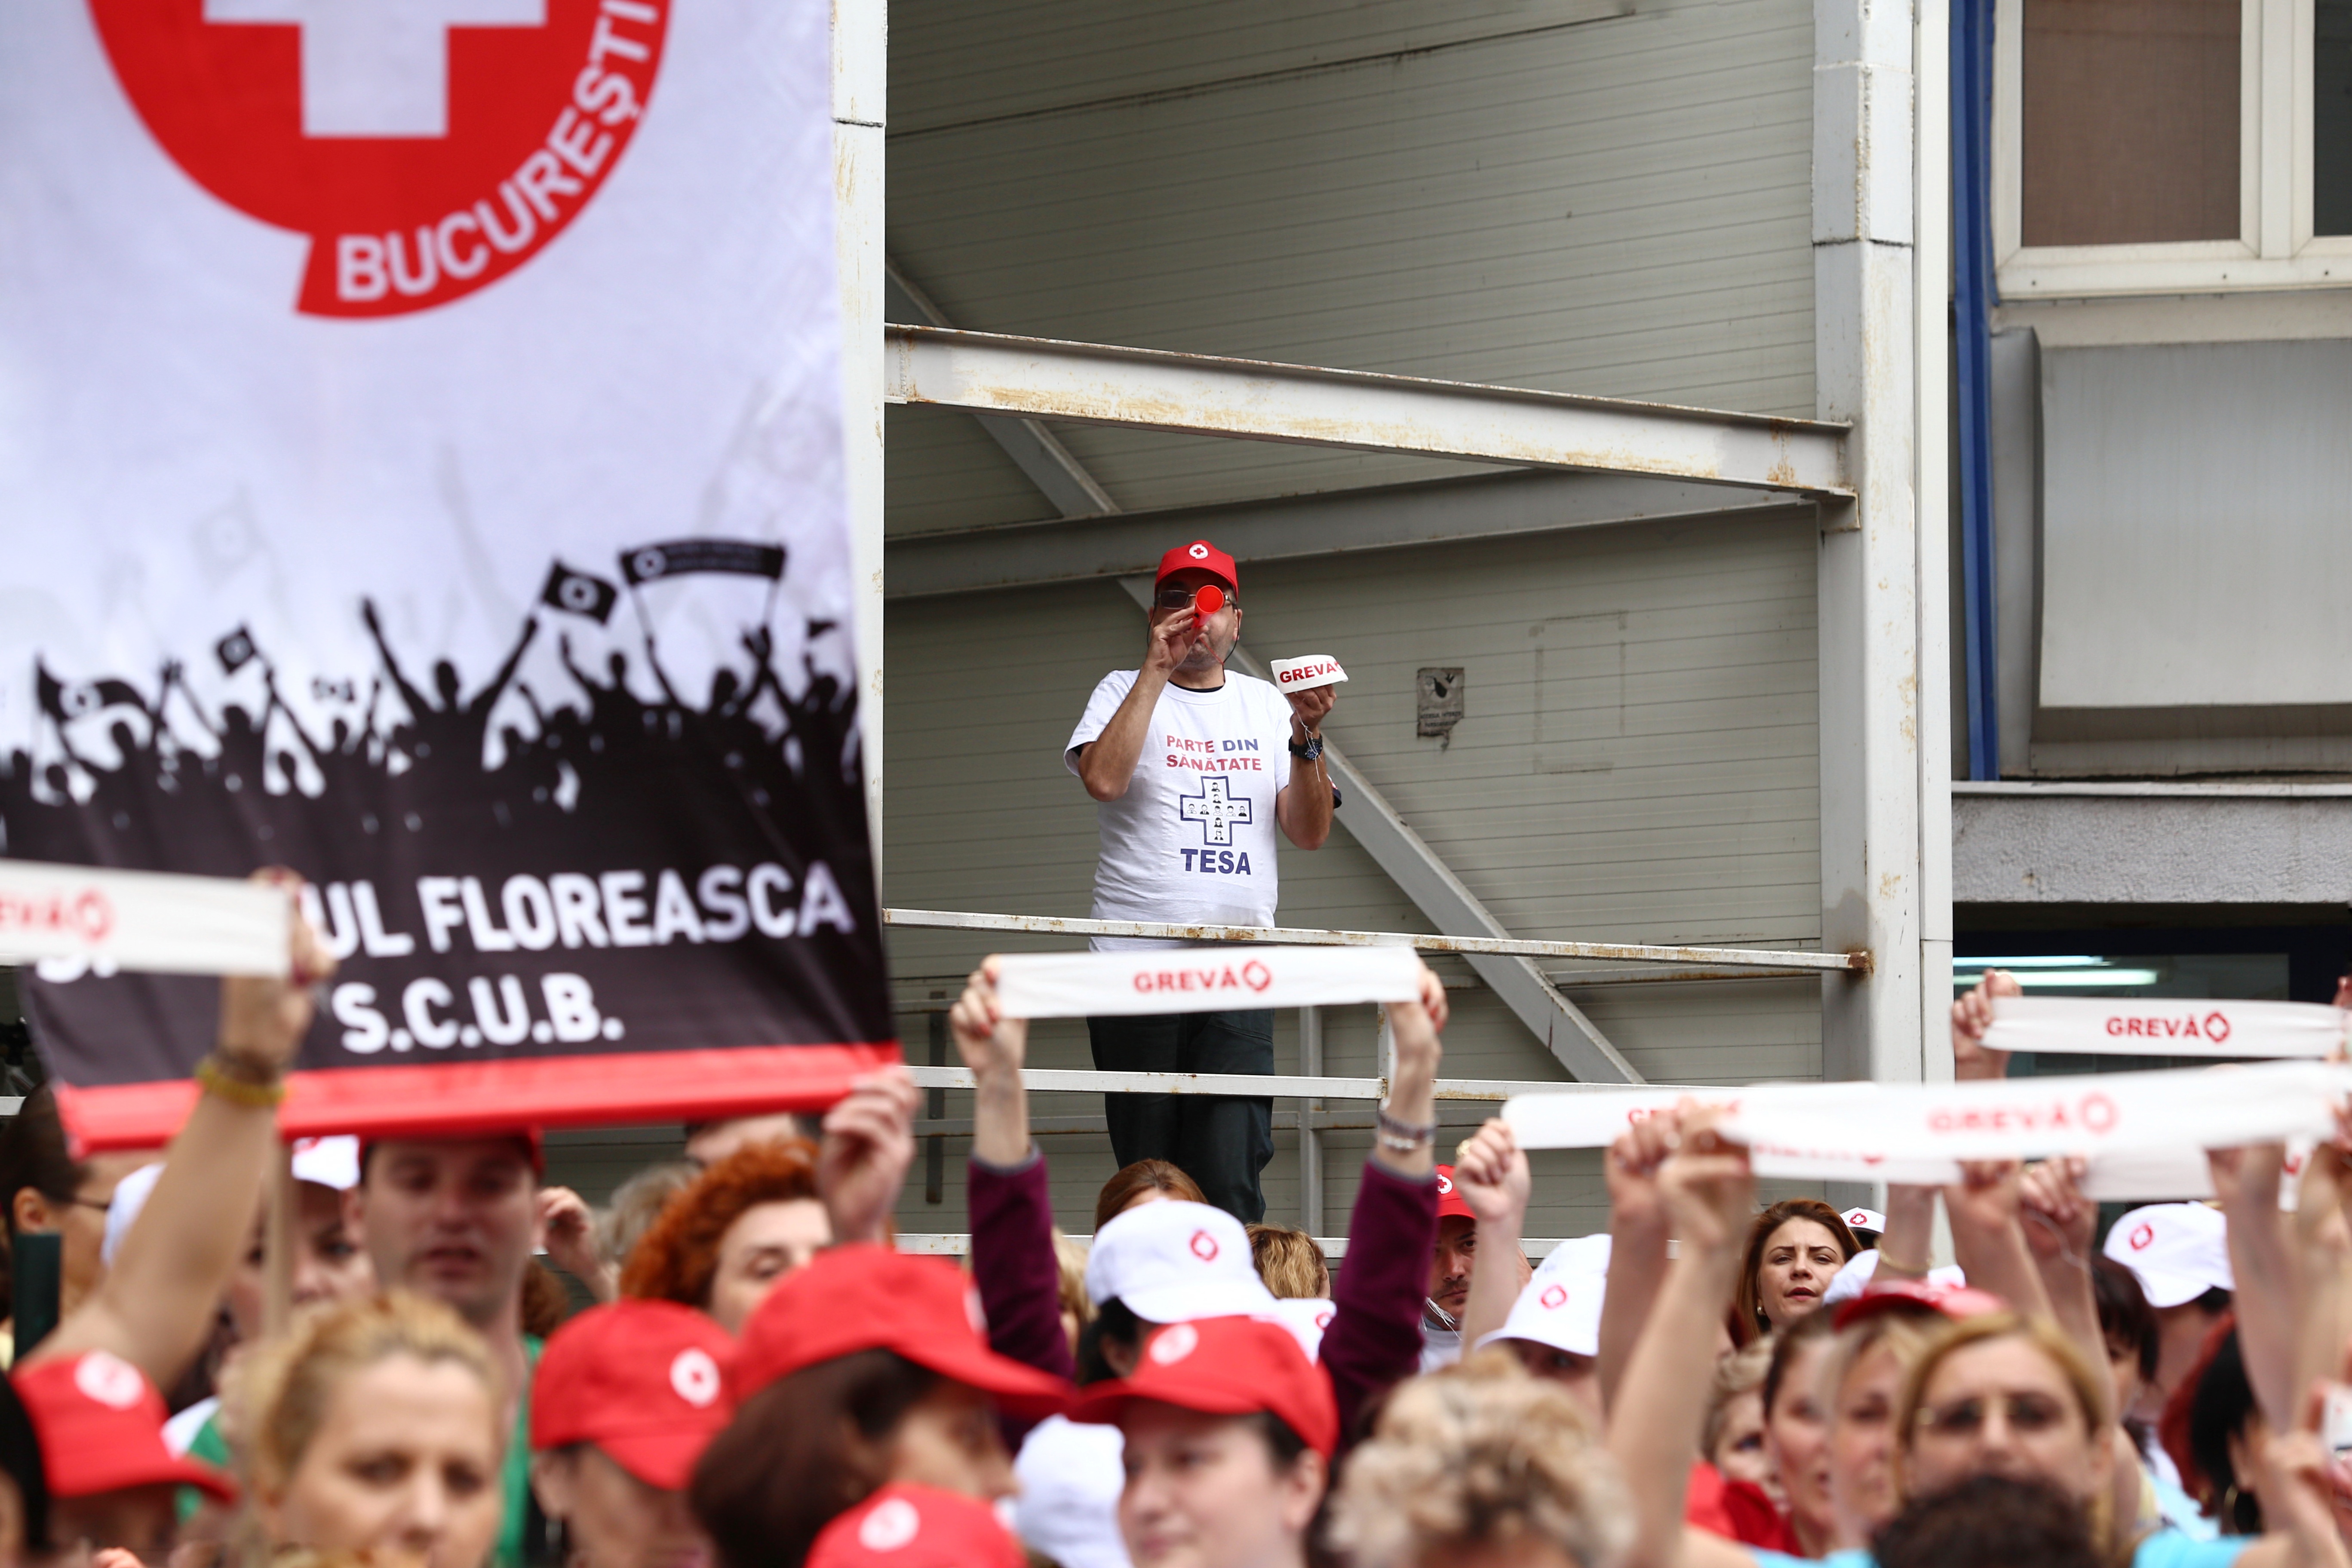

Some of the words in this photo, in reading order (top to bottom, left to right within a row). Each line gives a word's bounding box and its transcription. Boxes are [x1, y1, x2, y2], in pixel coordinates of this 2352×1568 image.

[1280, 661, 1336, 683] GREVĂ
[1167, 735, 1215, 753] PARTE
[1222, 739, 1259, 752] DIN
[1166, 753, 1262, 772] SĂNĂTATE
[1180, 848, 1251, 875] TESA
[417, 860, 855, 954] FLOREASCA
[332, 972, 625, 1053] S.C.U.B.
[2106, 1013, 2199, 1038] GREVĂ
